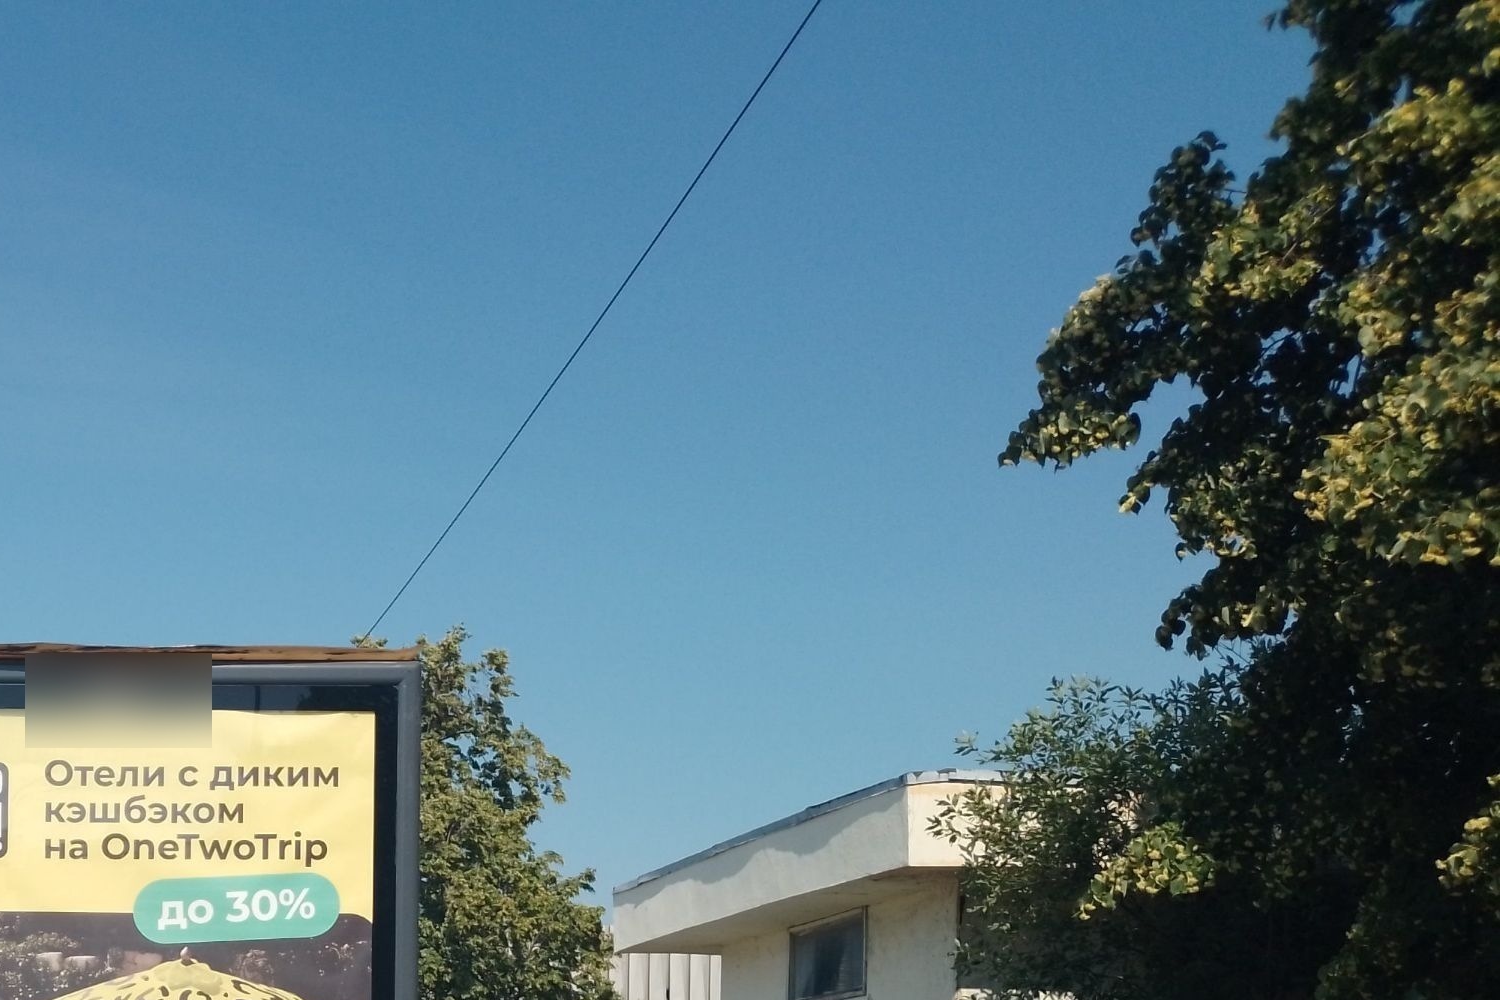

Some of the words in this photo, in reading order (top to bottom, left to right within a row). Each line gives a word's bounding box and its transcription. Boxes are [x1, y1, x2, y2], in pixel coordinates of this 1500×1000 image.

[45, 760, 164, 787] Отели
[178, 766, 198, 787] с
[209, 766, 339, 791] диким
[45, 796, 243, 823] кэшбэком
[45, 839, 88, 859] на
[101, 831, 327, 867] OneTwoTrip
[158, 900, 214, 930] до
[226, 888, 315, 922] 30%
